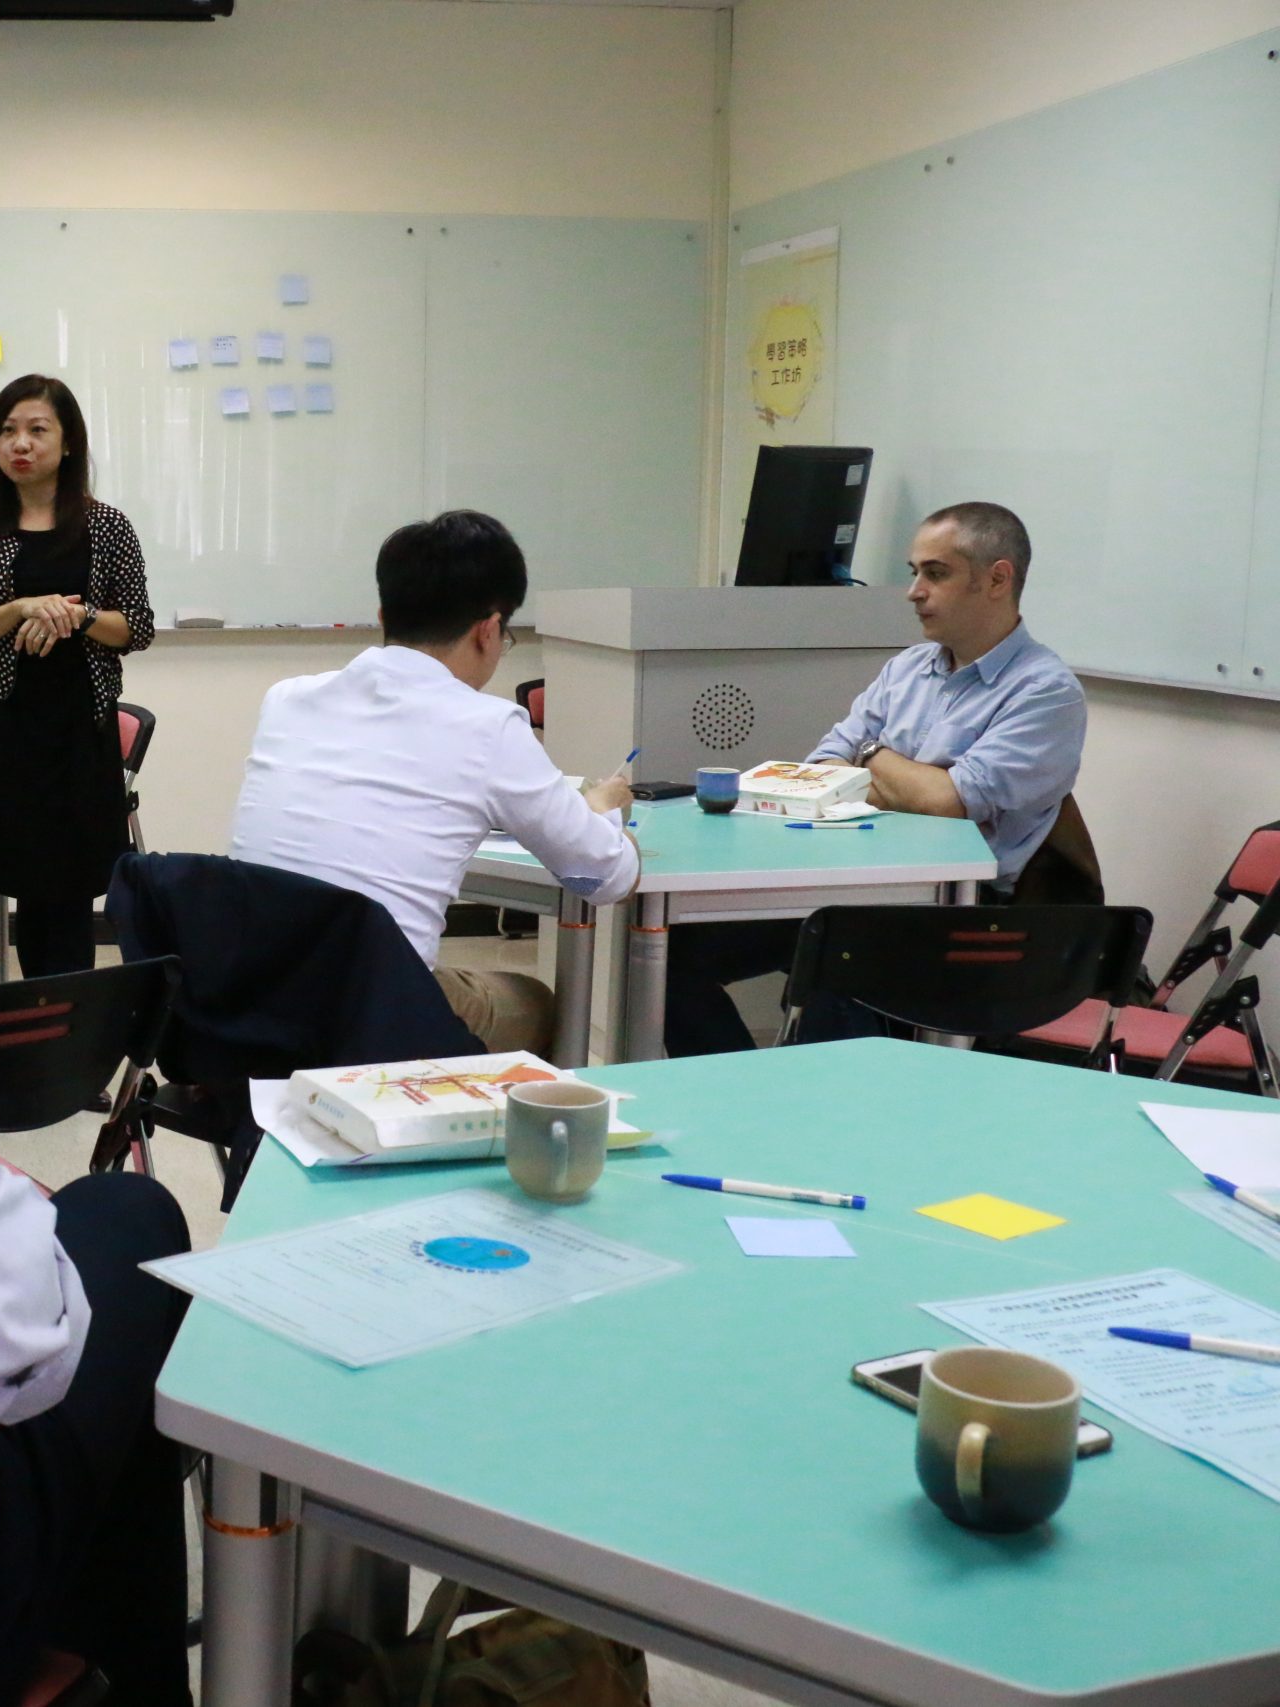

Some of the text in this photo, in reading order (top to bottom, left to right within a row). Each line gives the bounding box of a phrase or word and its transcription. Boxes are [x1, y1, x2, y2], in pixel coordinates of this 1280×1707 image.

[767, 338, 808, 361] 學習策略
[771, 366, 802, 386] 工作坊
